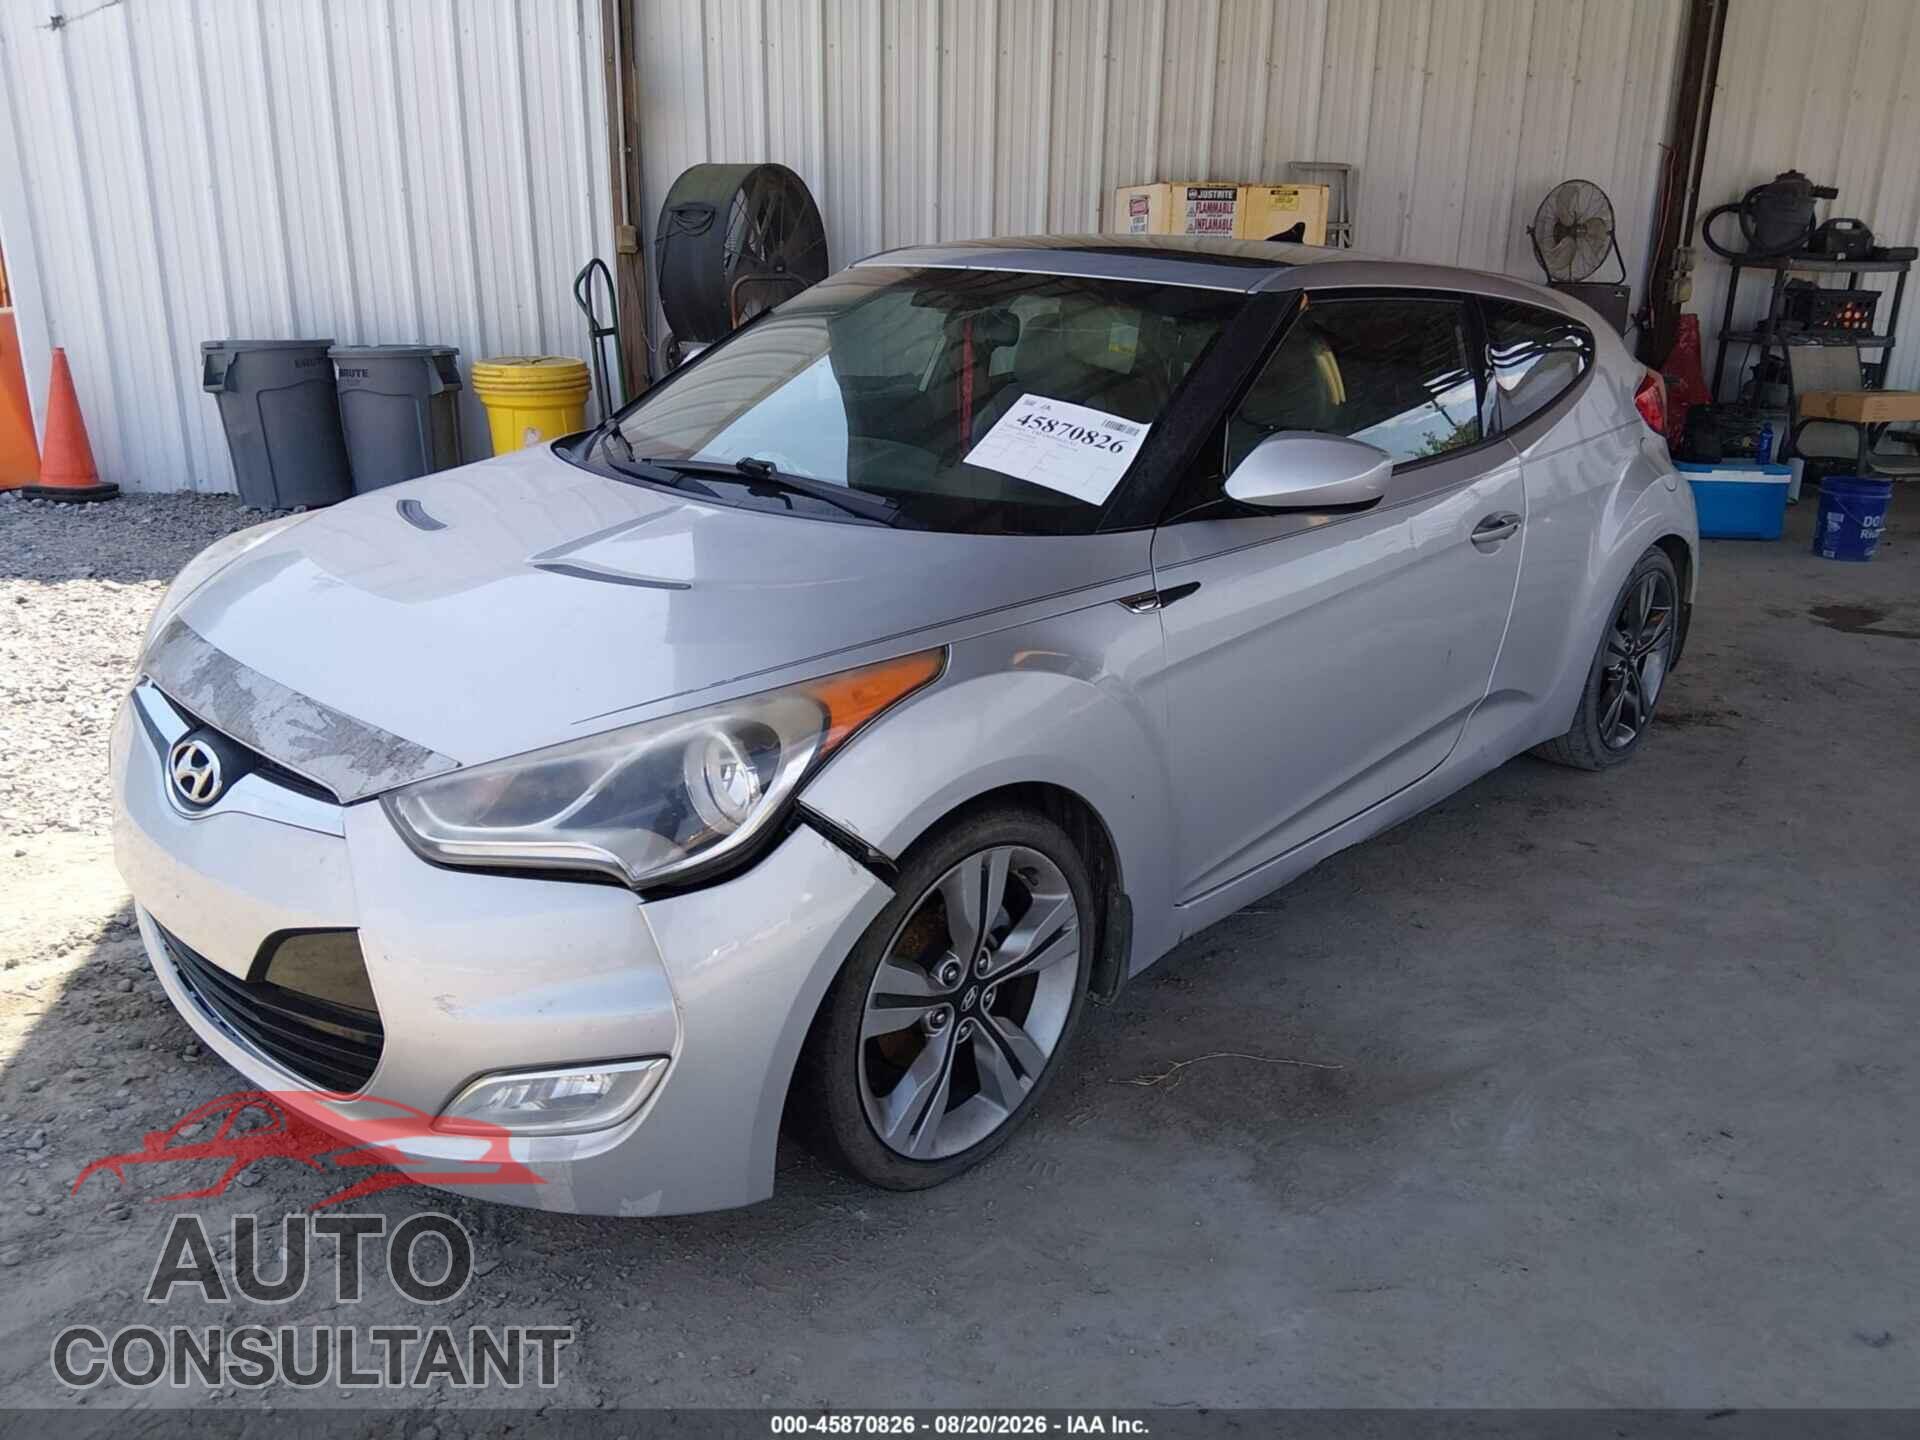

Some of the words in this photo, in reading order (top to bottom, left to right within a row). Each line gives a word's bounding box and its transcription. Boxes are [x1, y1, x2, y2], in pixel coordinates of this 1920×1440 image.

[1196, 202, 1233, 214] FLAMMABLE
[339, 368, 368, 377] BRUTE
[1016, 413, 1129, 454] 45870826
